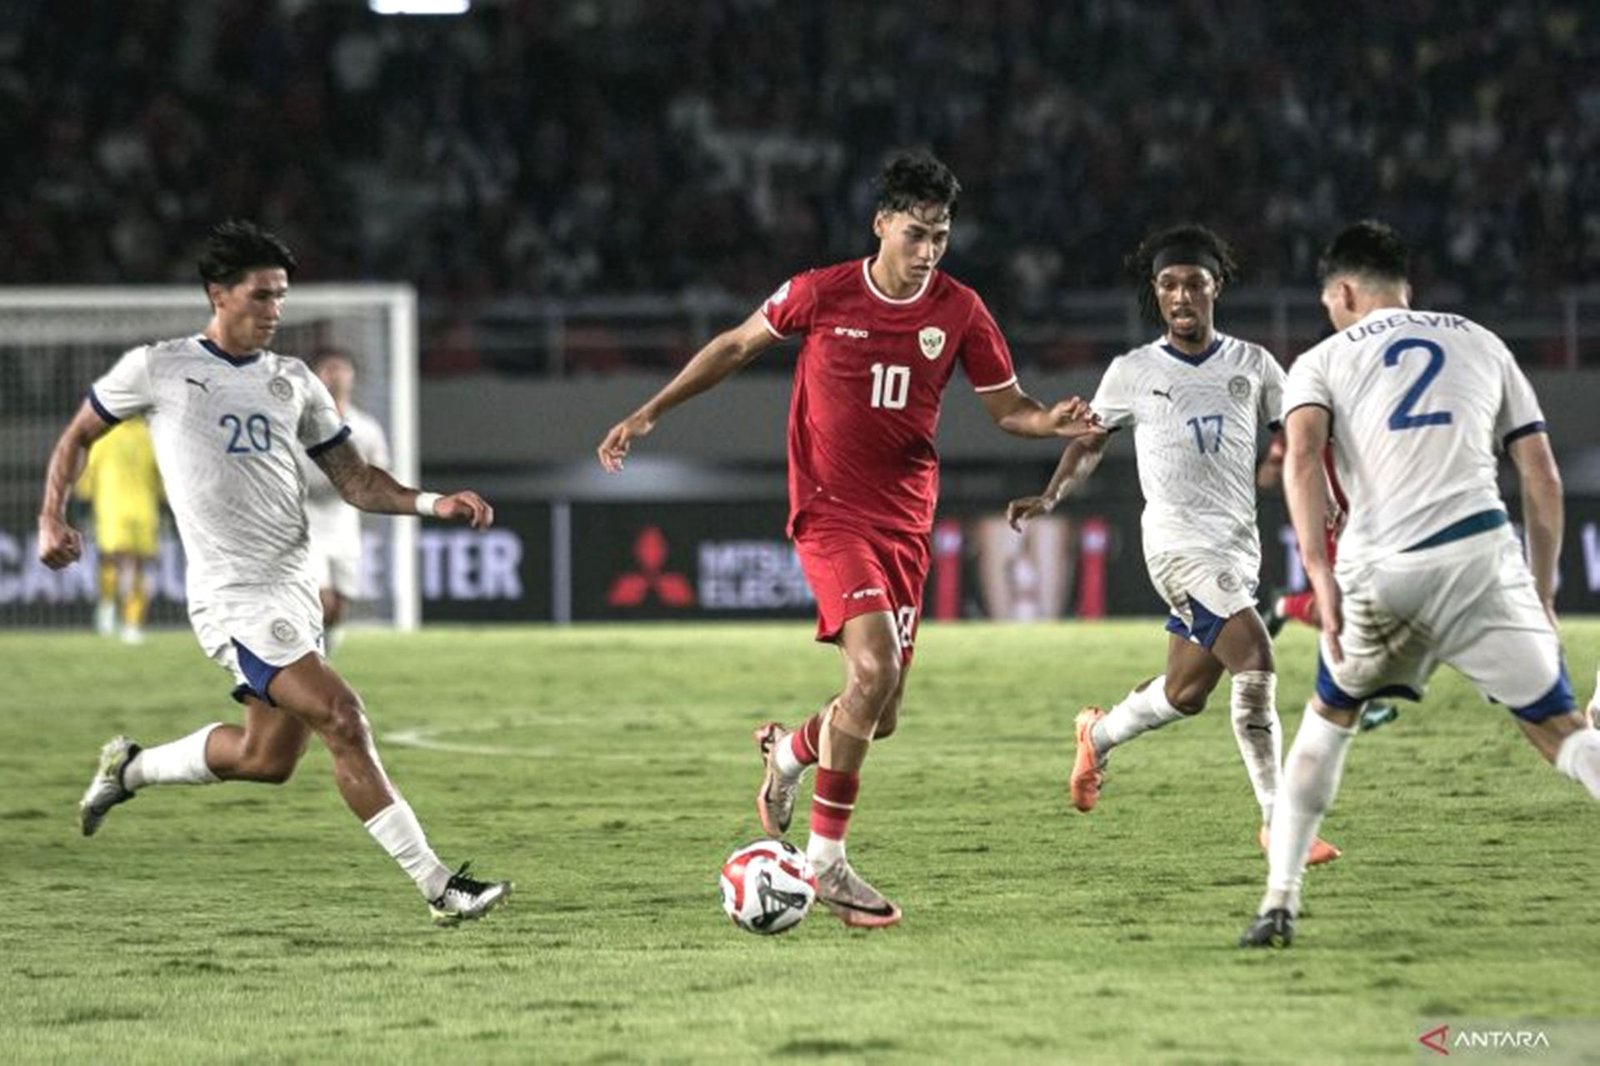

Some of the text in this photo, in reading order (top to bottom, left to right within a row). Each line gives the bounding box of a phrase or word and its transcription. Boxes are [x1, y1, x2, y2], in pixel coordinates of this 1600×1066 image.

[1346, 314, 1470, 342] UGELVIK
[870, 363, 911, 409] 10
[1383, 338, 1453, 431] 2
[219, 413, 271, 453] 20
[1186, 414, 1223, 454] 17
